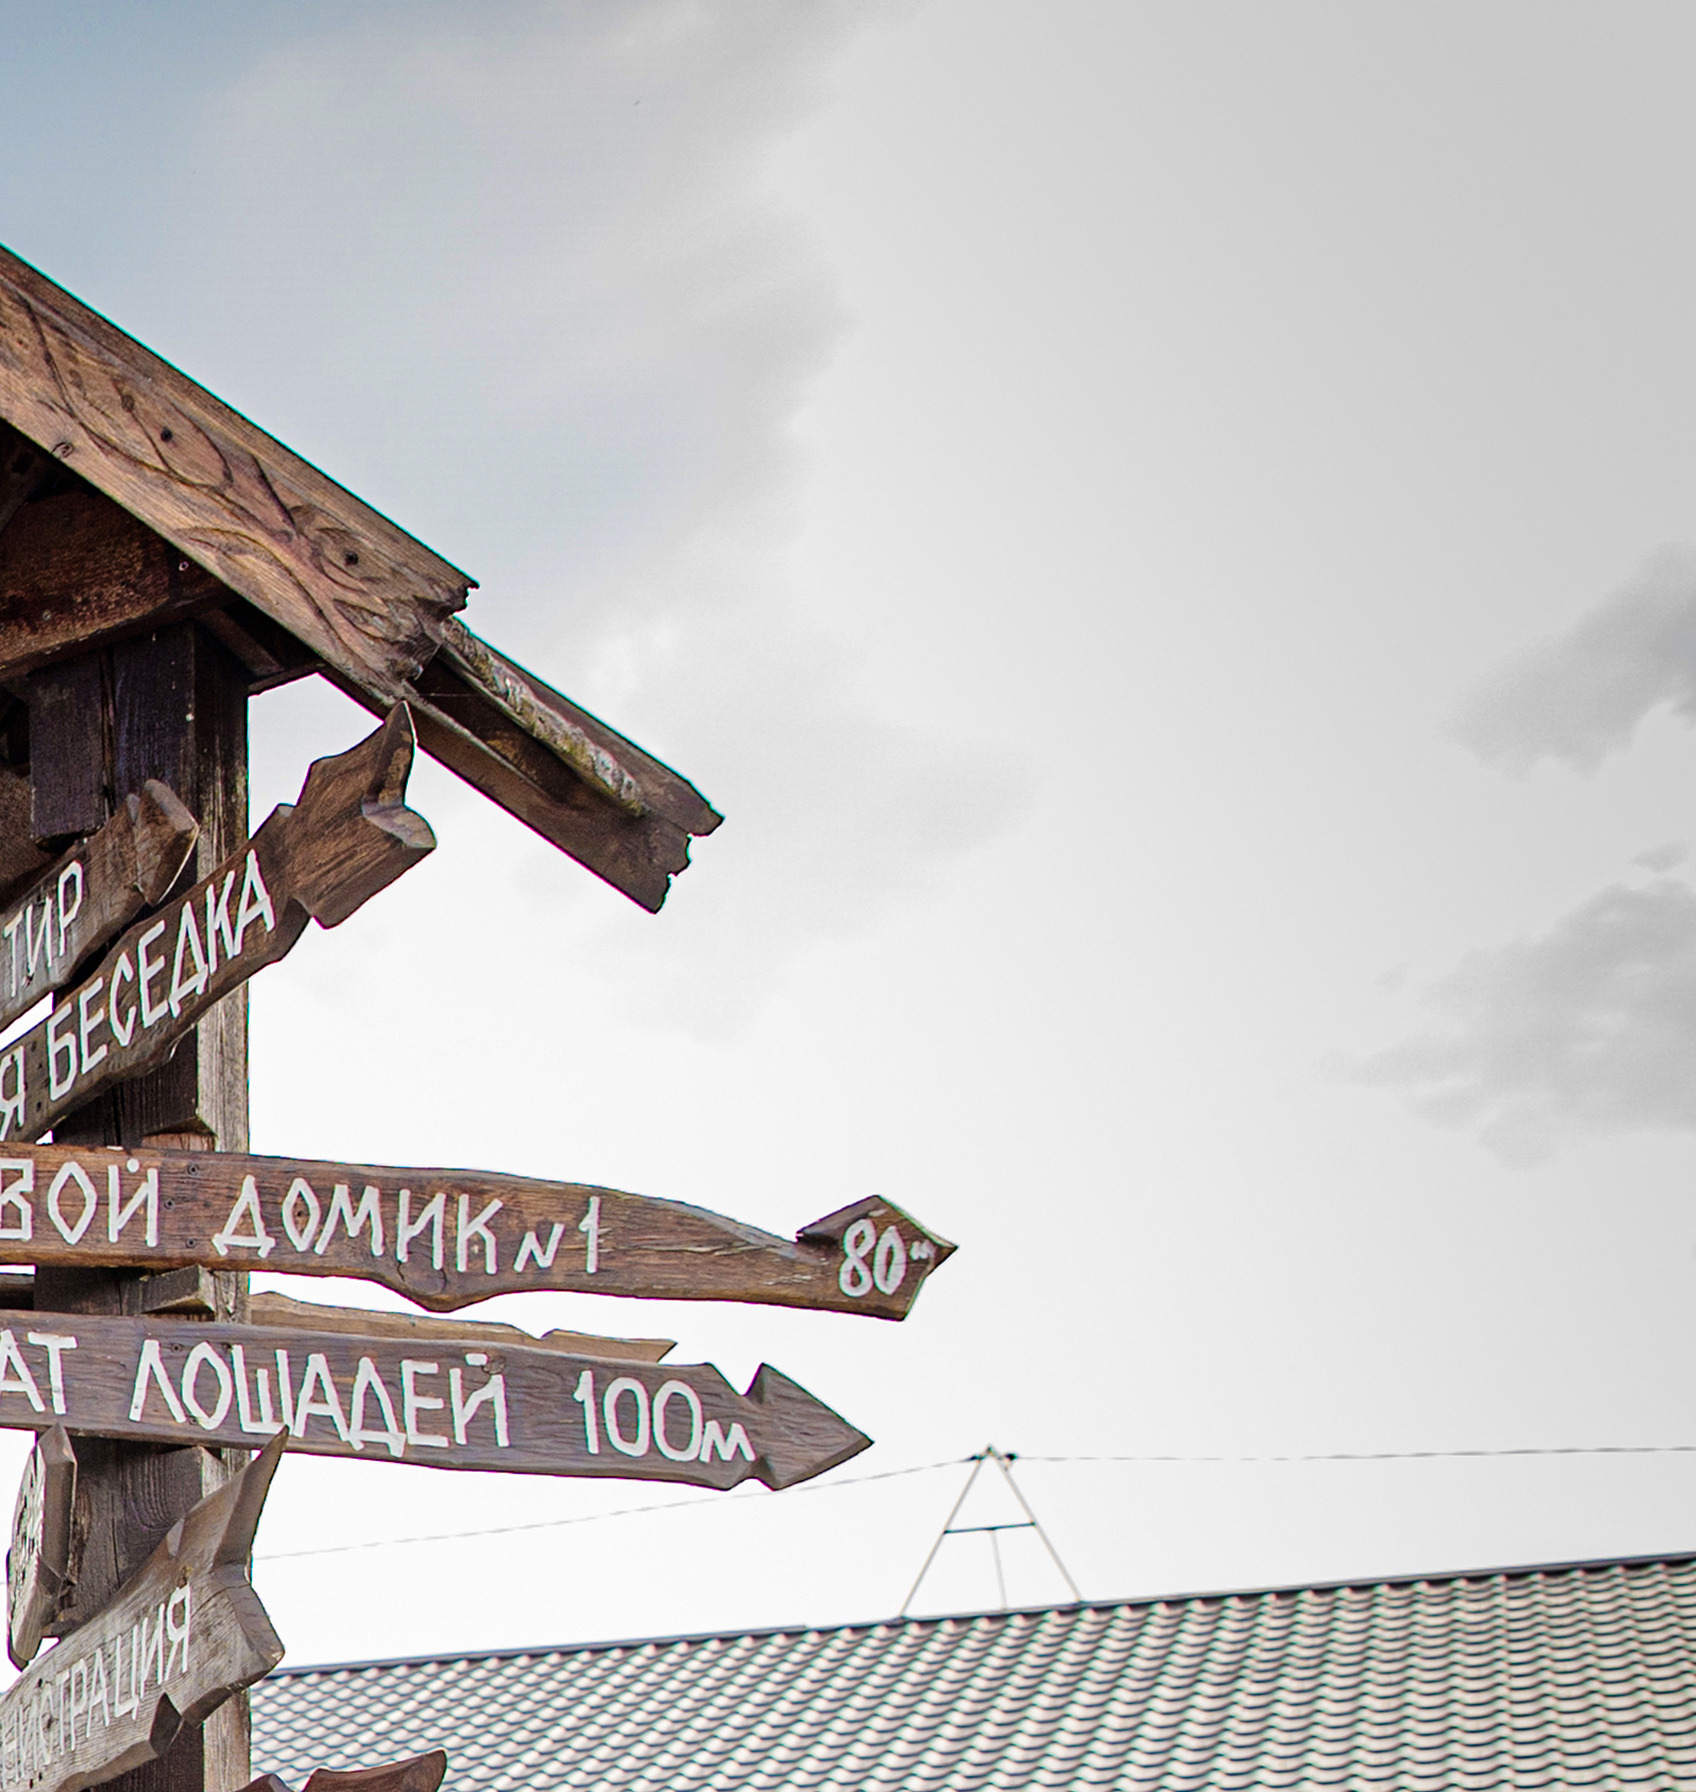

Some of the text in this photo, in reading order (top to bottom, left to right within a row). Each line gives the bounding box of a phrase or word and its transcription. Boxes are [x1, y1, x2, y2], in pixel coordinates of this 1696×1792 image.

[3, 859, 84, 998] ТИР
[47, 848, 277, 1101] БЕСЕДКА
[212, 1174, 503, 1275] ДОМИК
[128, 1338, 509, 1458] ЛОШАДЕЙ
